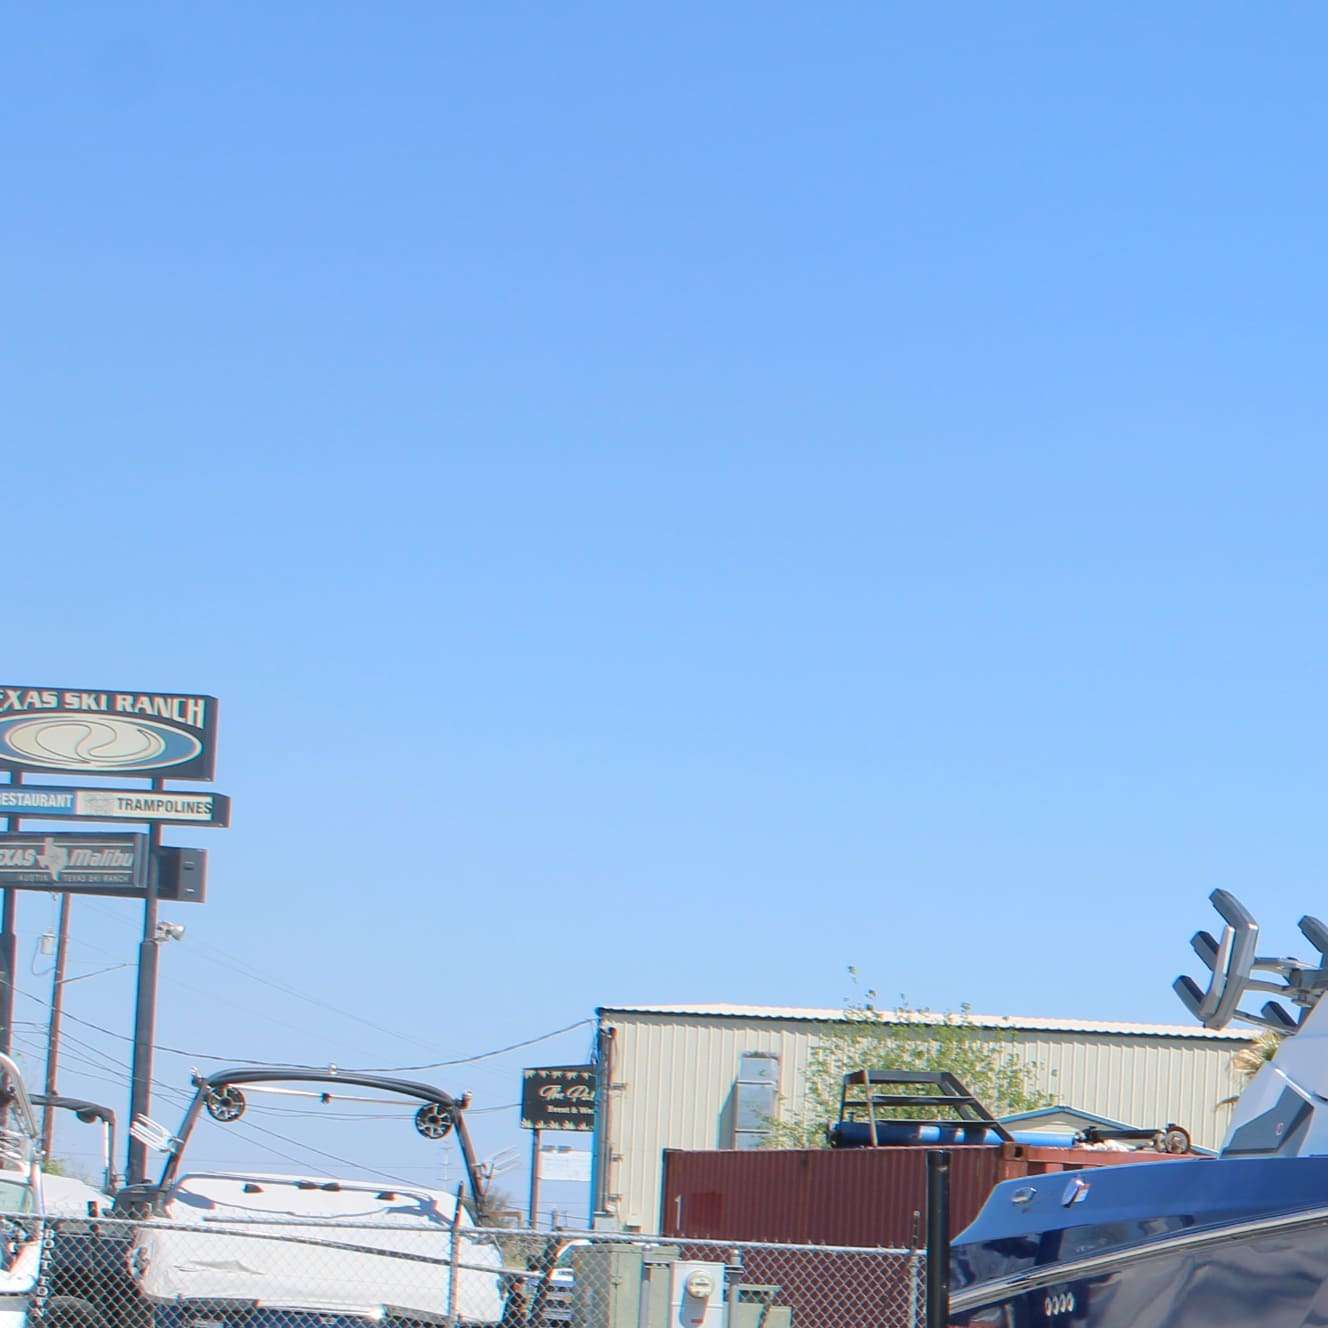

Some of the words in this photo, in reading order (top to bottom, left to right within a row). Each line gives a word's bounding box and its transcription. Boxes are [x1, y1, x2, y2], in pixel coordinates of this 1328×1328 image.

[0, 689, 58, 713] XAS
[64, 692, 108, 712] SKI
[117, 694, 206, 730] RANCH
[0, 792, 73, 809] ESTAURANT
[117, 797, 213, 816] TRAMPOLINES
[0, 848, 37, 867] XAS
[69, 848, 134, 867] Malibu
